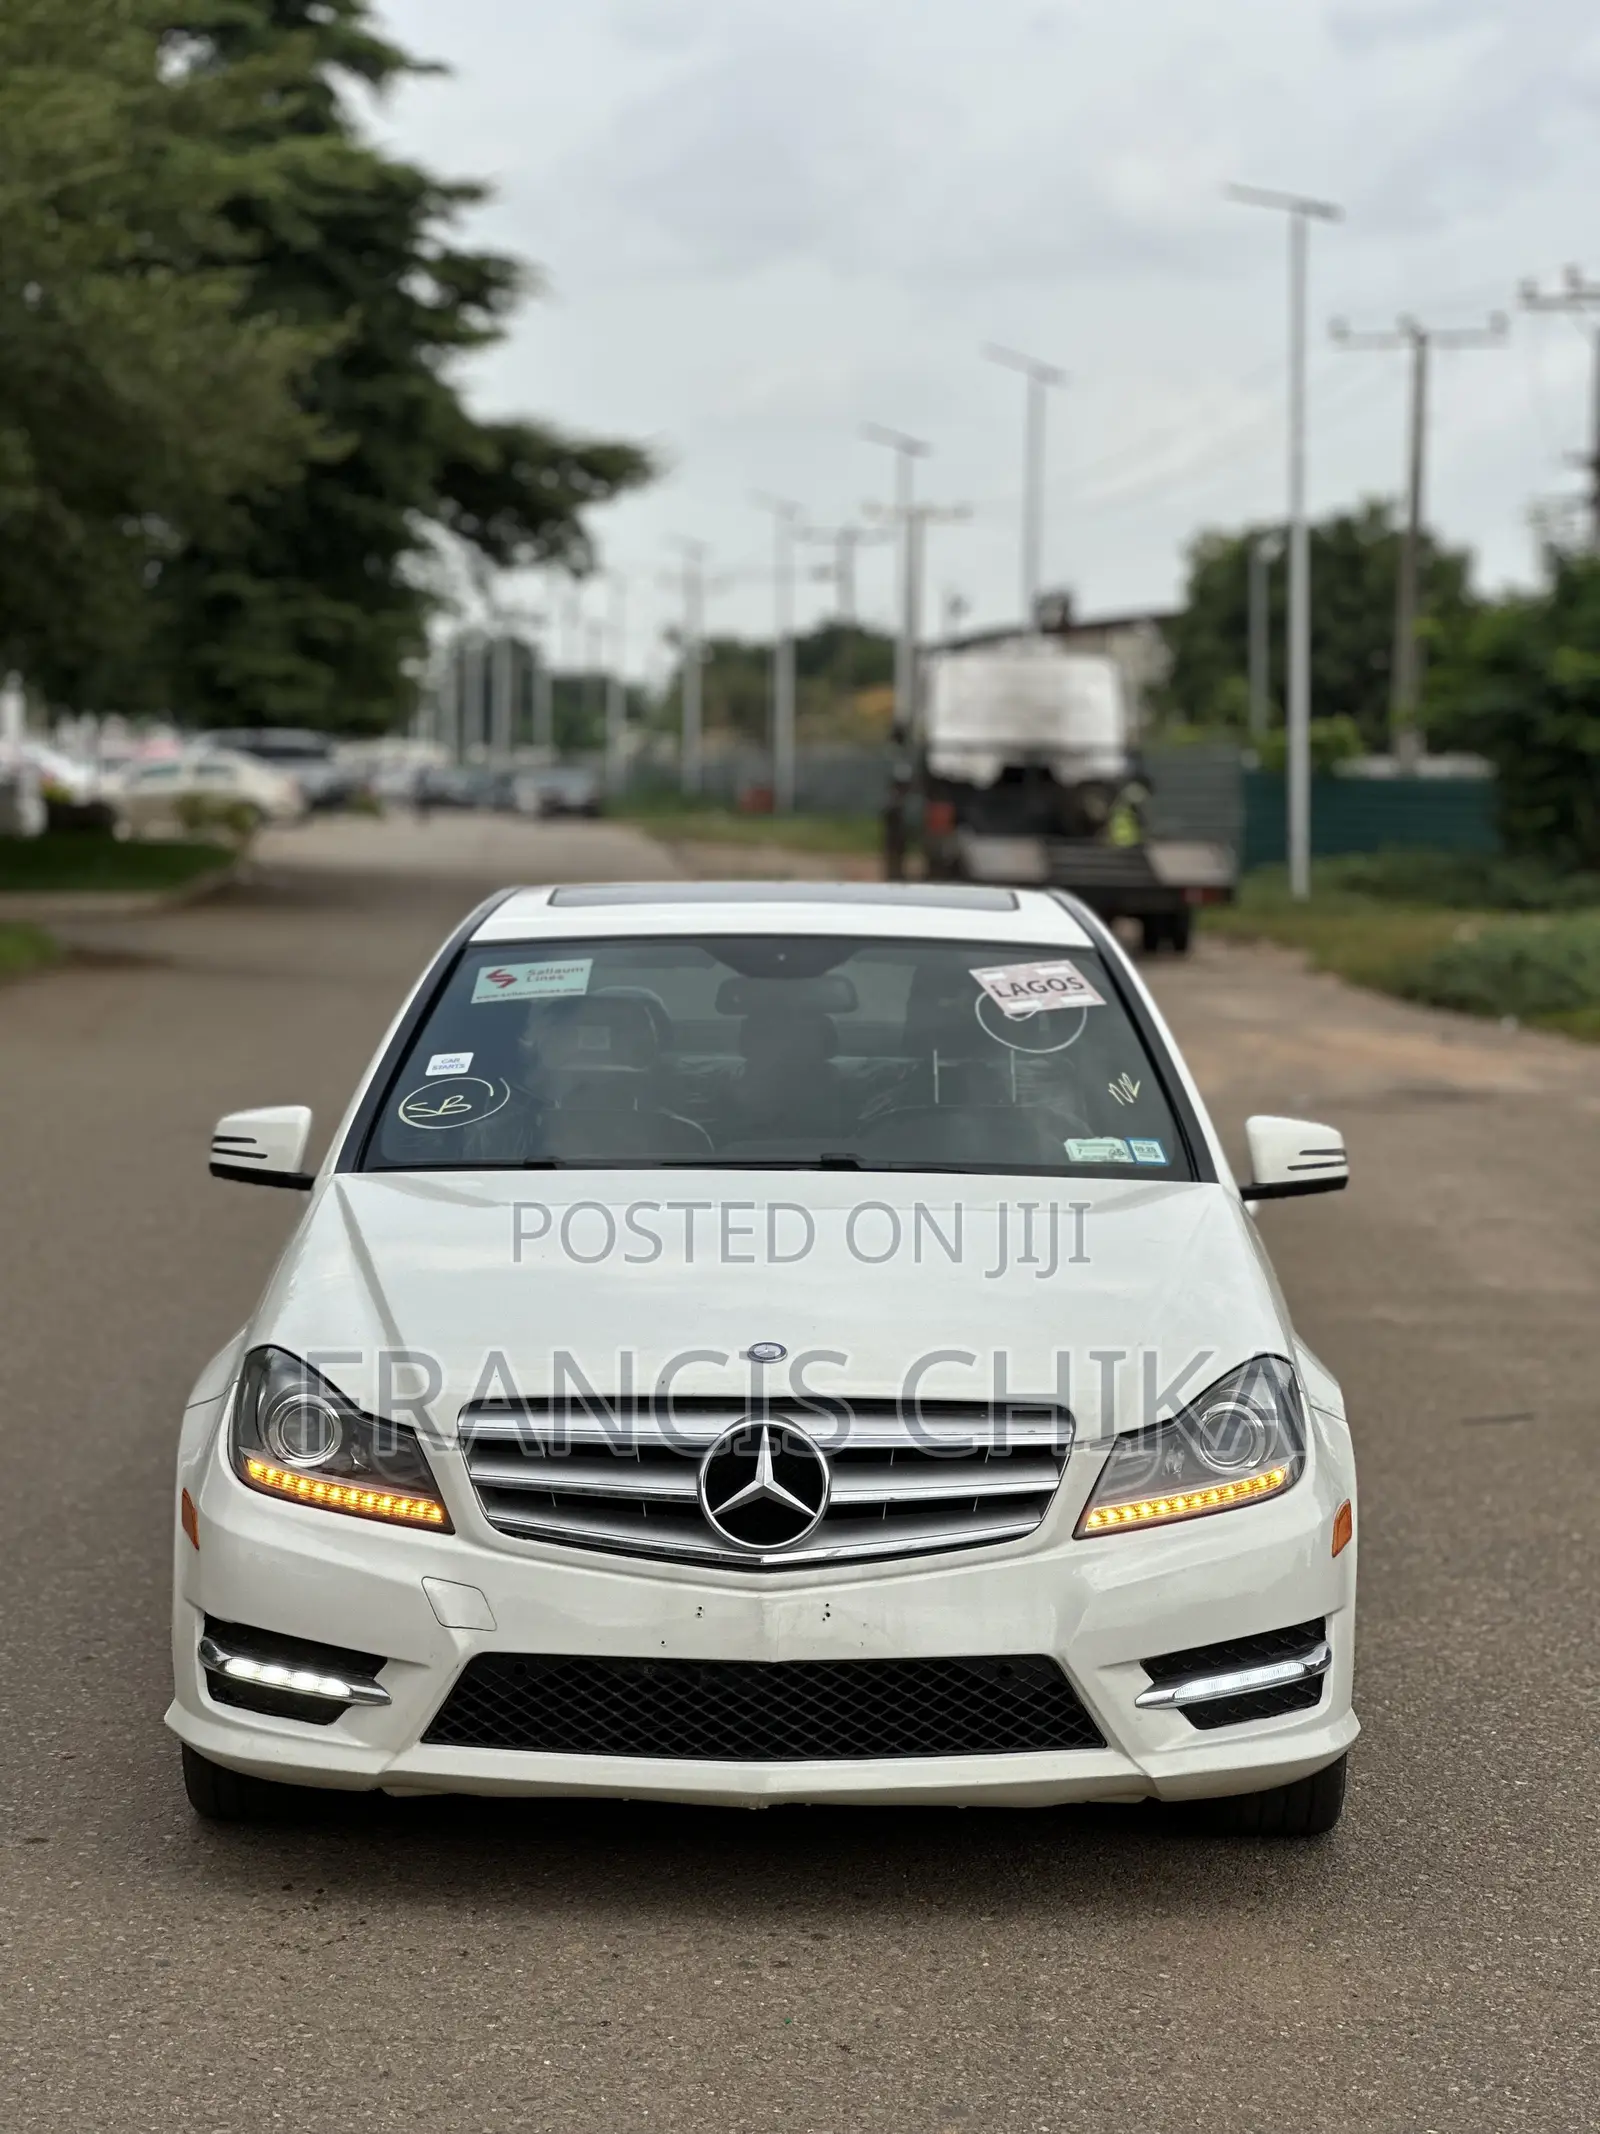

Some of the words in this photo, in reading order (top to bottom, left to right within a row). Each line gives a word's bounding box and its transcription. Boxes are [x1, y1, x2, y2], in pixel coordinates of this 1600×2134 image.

[990, 976, 1085, 998] LAGOS
[441, 1057, 461, 1065] CAR
[431, 1063, 465, 1071] STARTS
